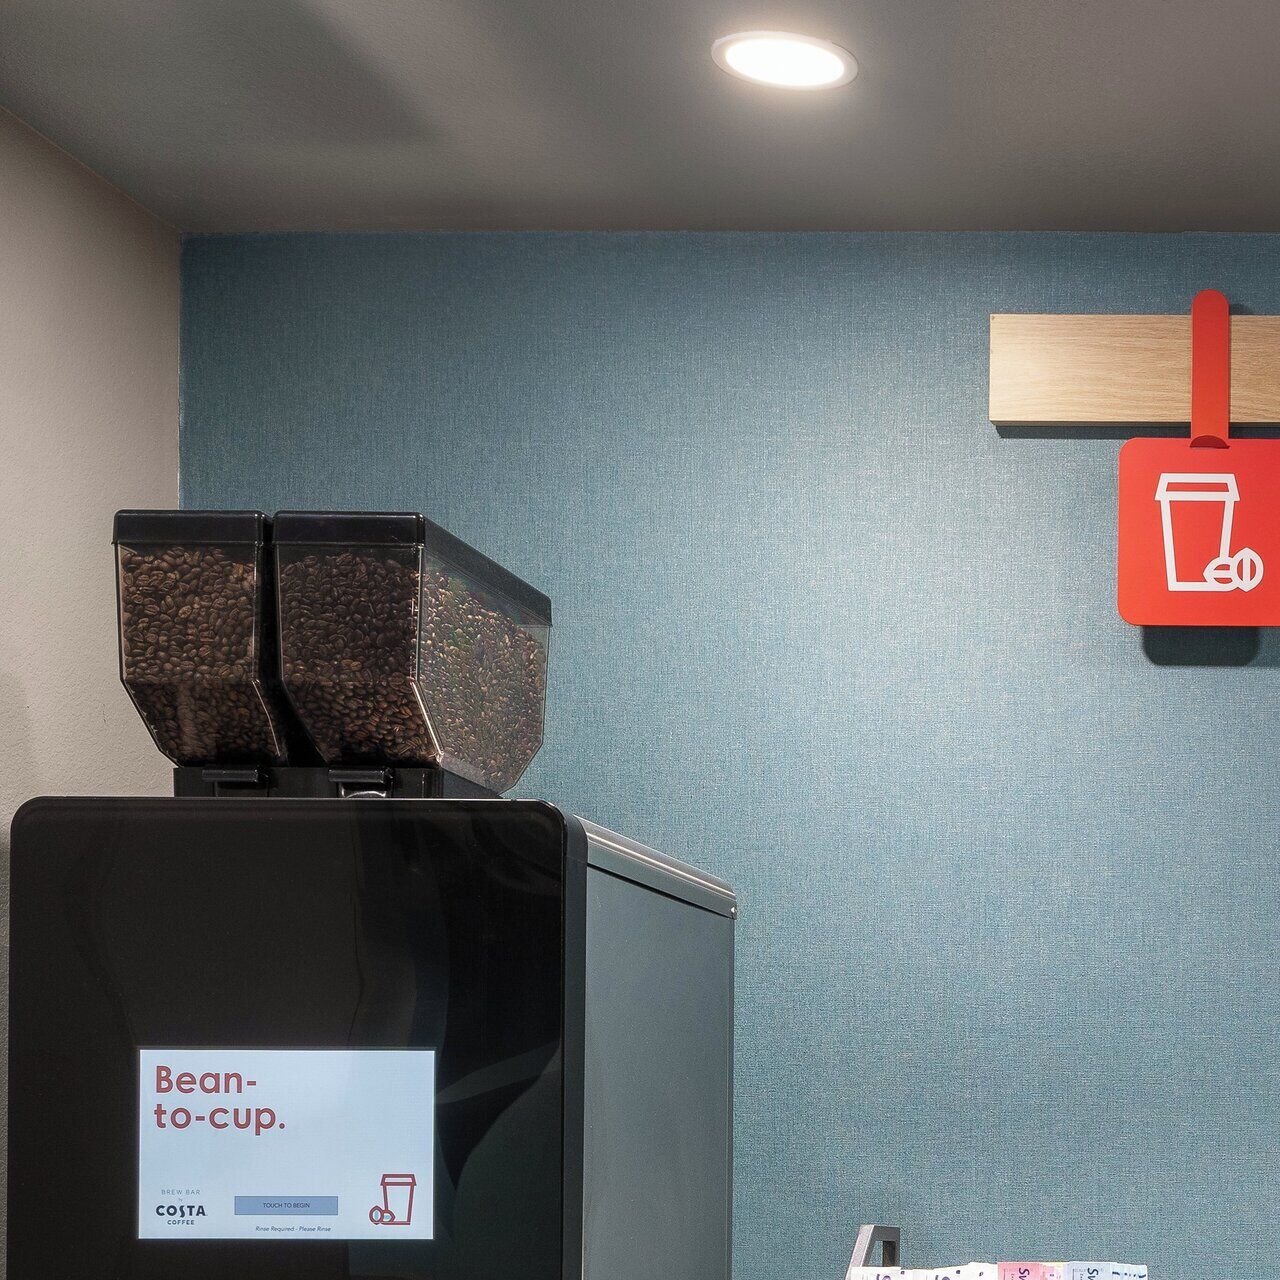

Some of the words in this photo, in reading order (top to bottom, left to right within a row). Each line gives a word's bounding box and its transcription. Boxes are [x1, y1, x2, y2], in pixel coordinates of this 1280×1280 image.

[156, 1065, 257, 1093] Bean-
[154, 1104, 286, 1135] to-cup.
[156, 1205, 206, 1218] COSTA
